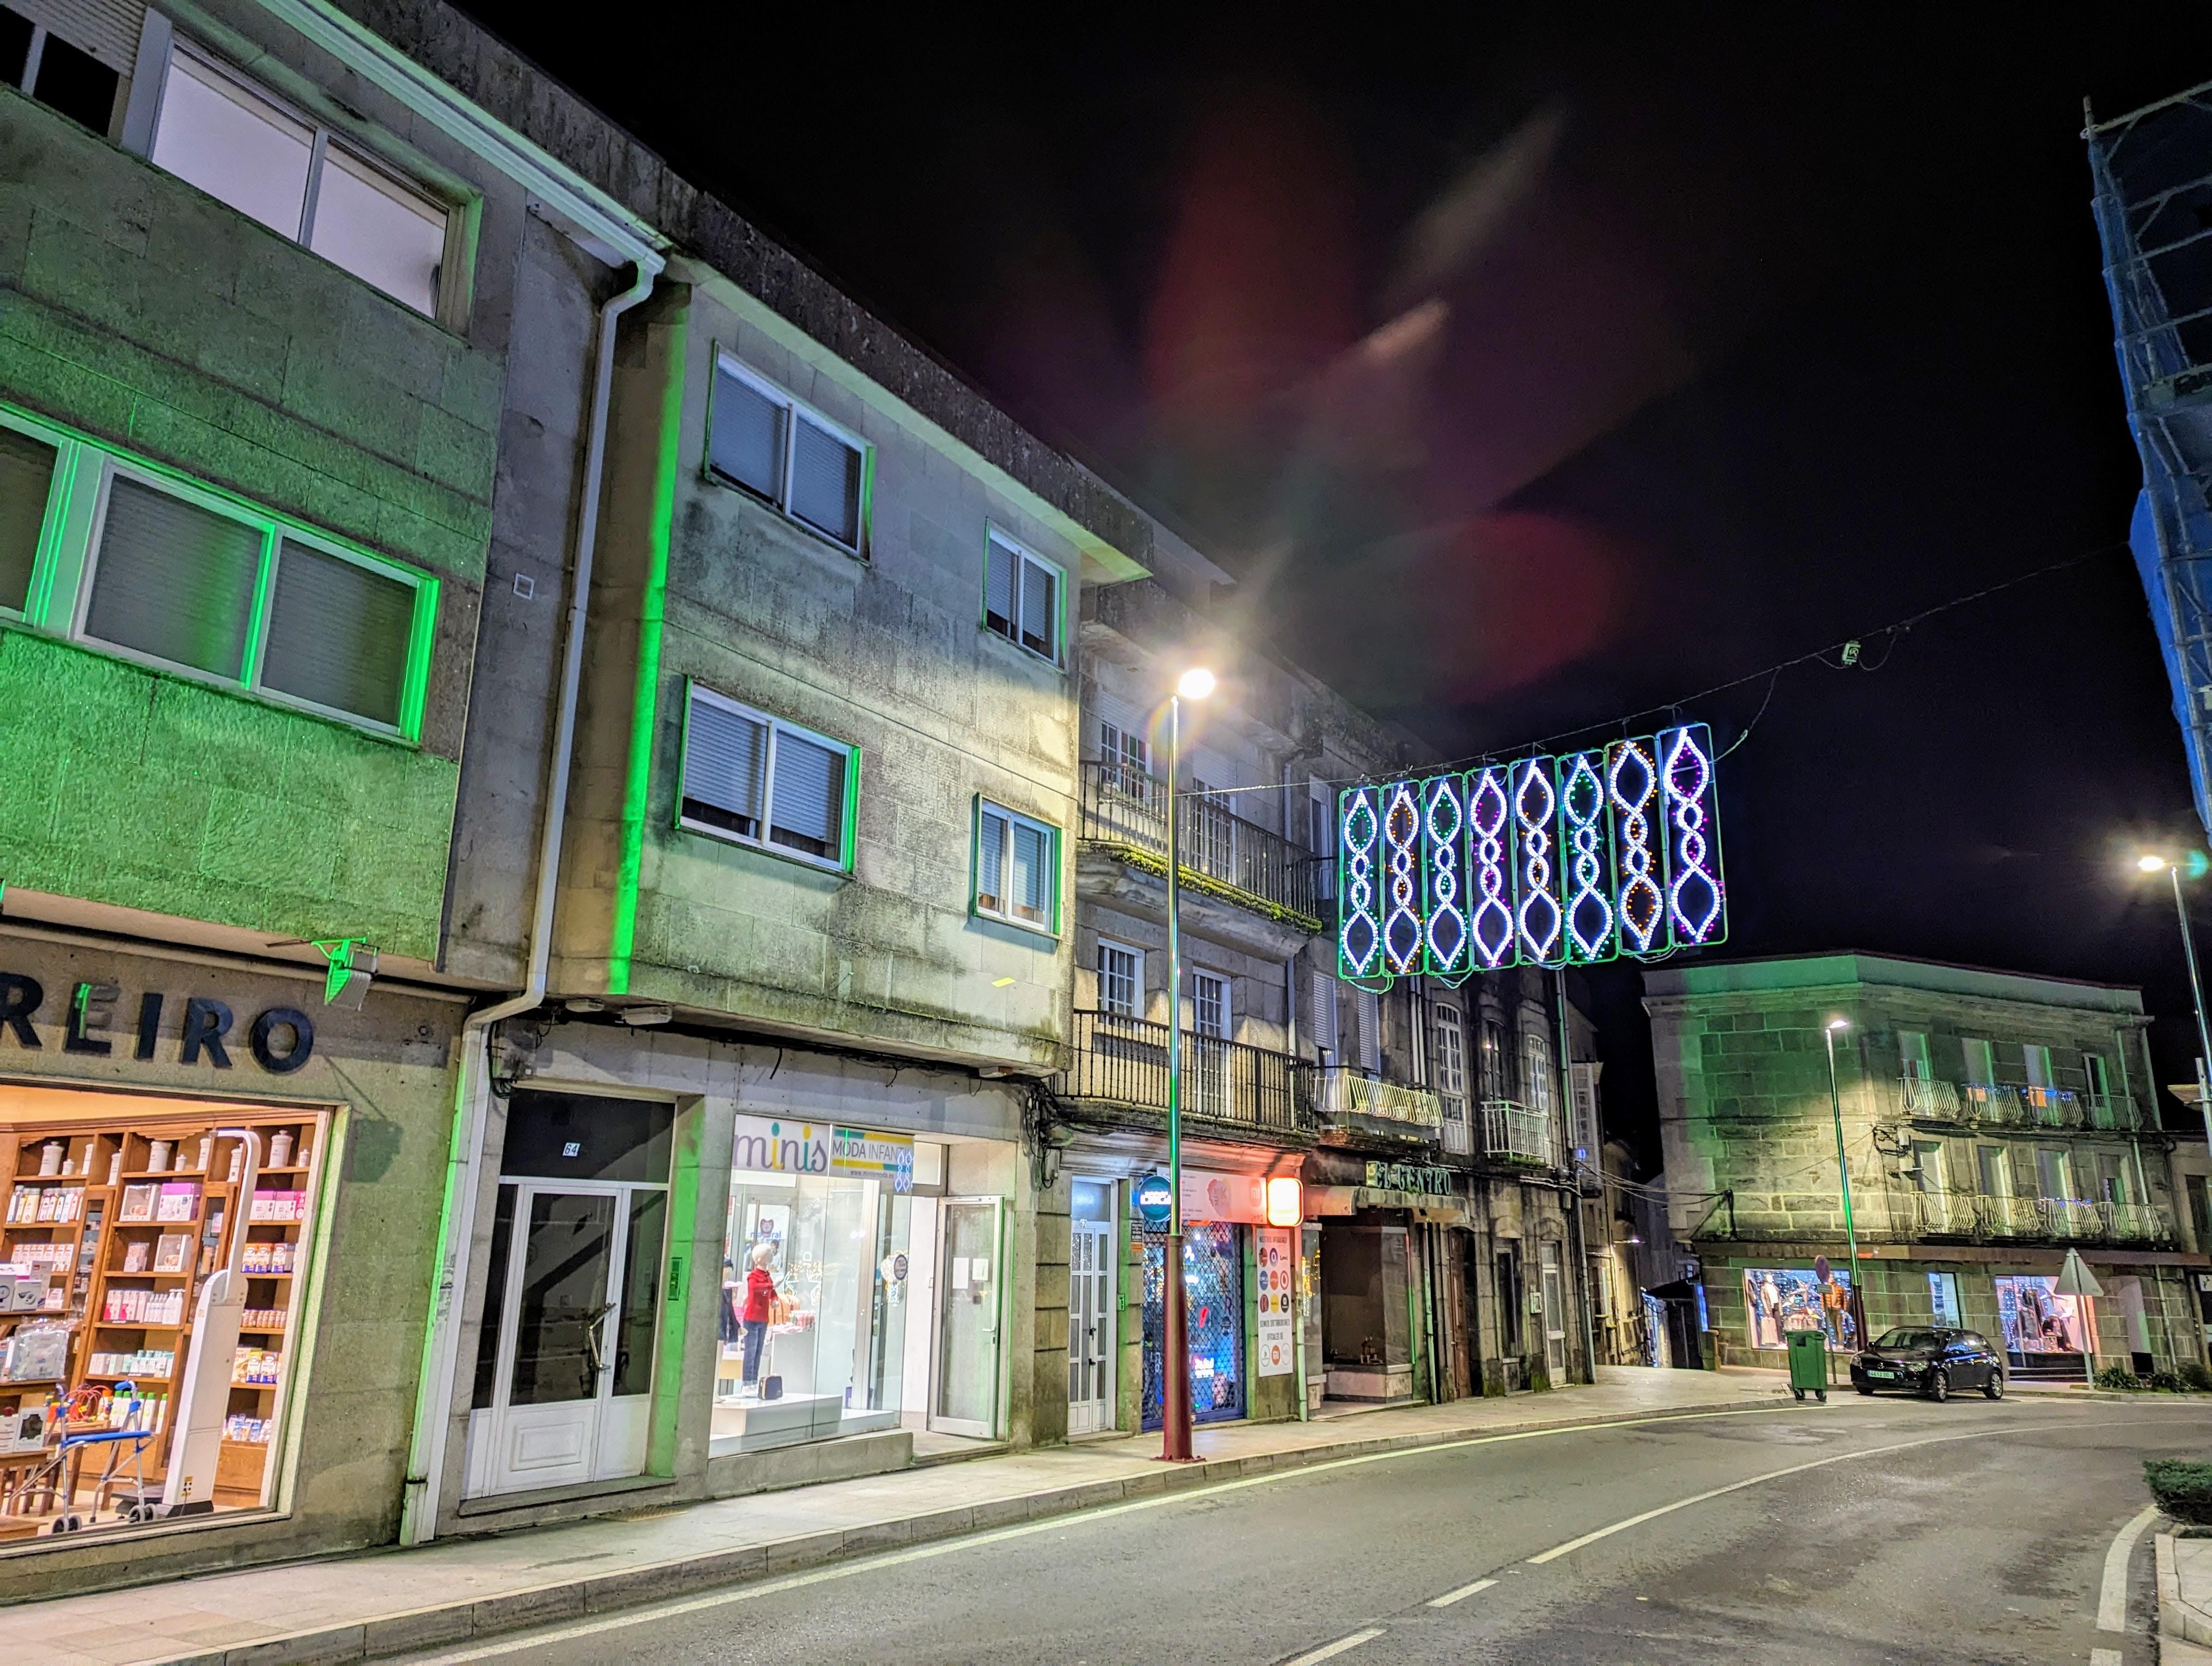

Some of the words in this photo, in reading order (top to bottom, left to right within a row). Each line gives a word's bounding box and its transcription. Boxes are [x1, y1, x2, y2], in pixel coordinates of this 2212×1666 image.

[0, 972, 314, 1075] REIRO
[565, 1144, 577, 1155] 64
[732, 1122, 827, 1172] minis
[832, 1140, 866, 1158] MODA
[1375, 1161, 1391, 1189] EL
[1398, 1165, 1451, 1195] CENTRO
